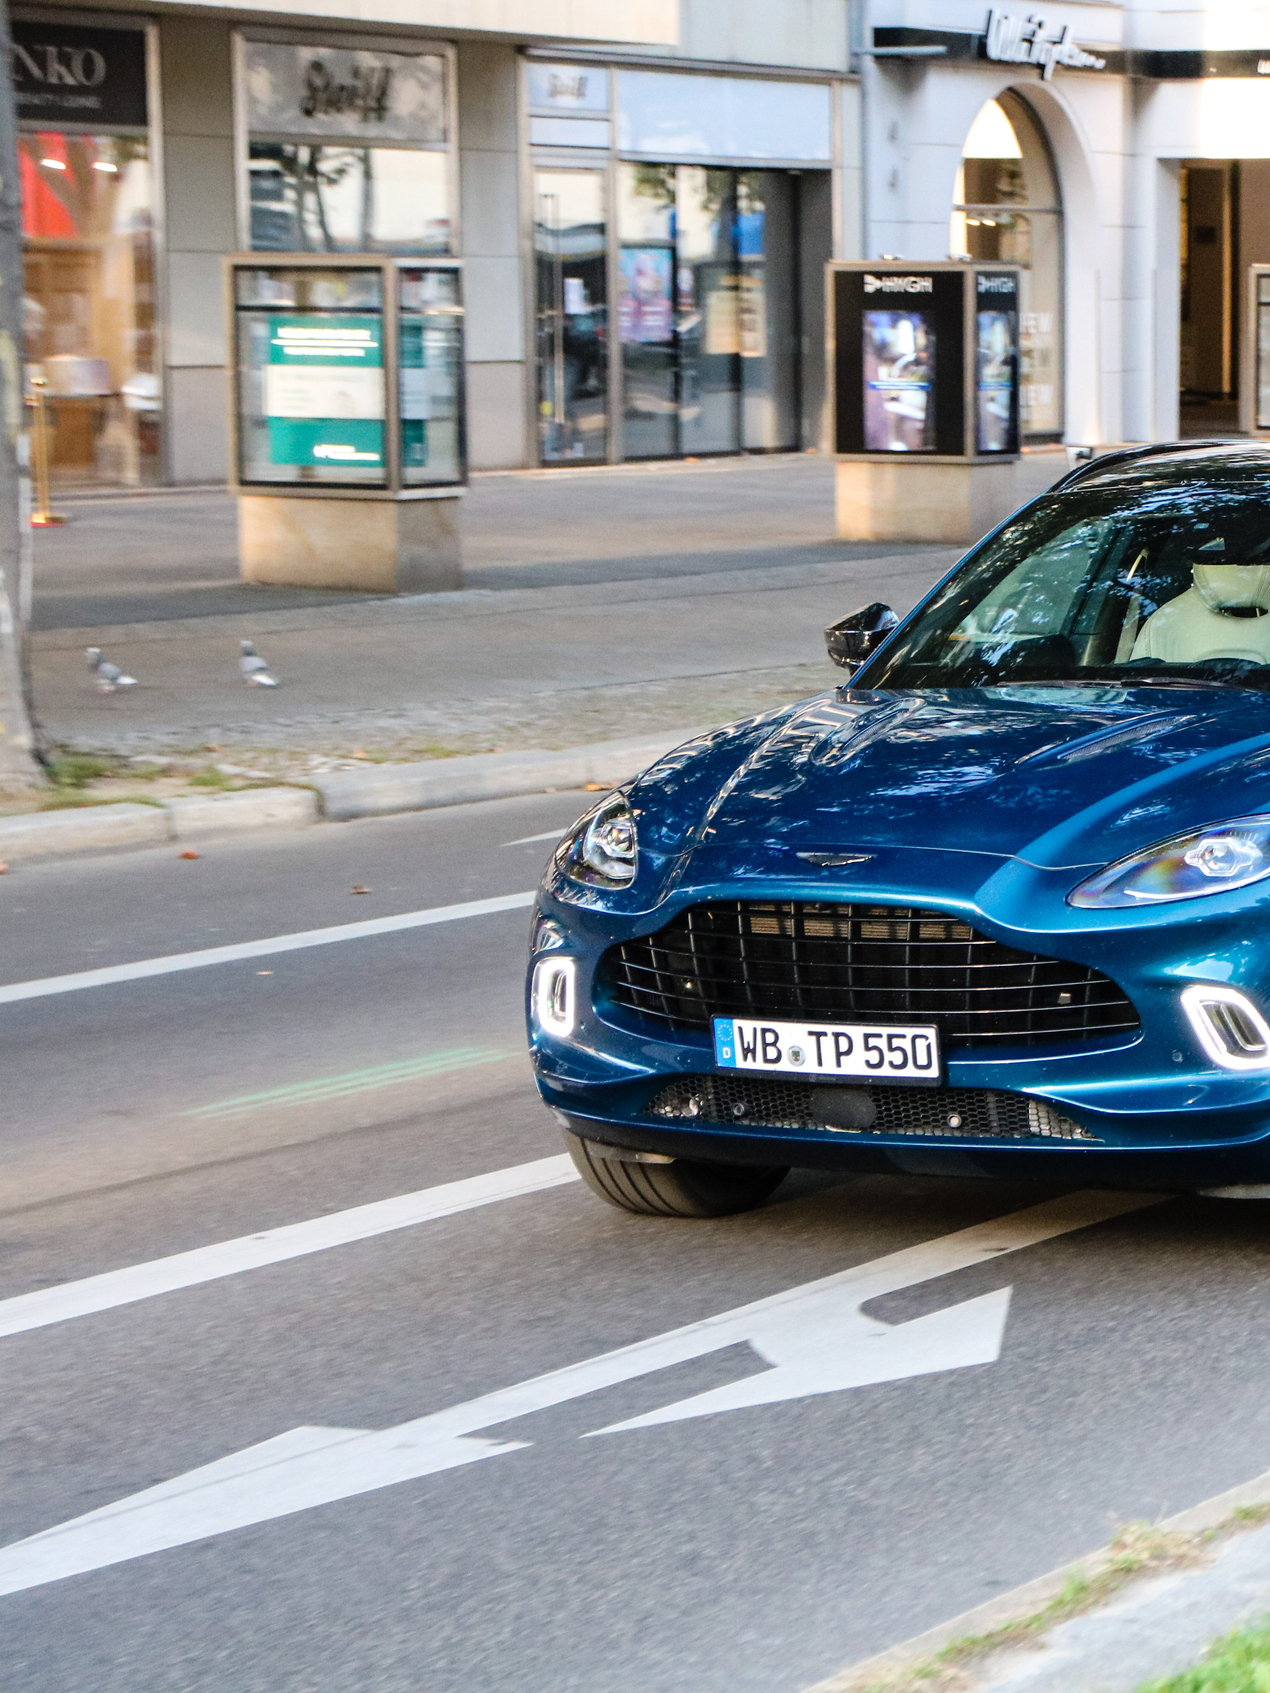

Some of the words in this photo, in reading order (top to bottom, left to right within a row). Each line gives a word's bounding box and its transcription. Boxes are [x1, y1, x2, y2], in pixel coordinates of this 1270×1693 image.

[12, 44, 107, 87] NKO
[738, 1025, 783, 1065] WB
[807, 1030, 854, 1068] TP
[863, 1032, 933, 1070] 550
